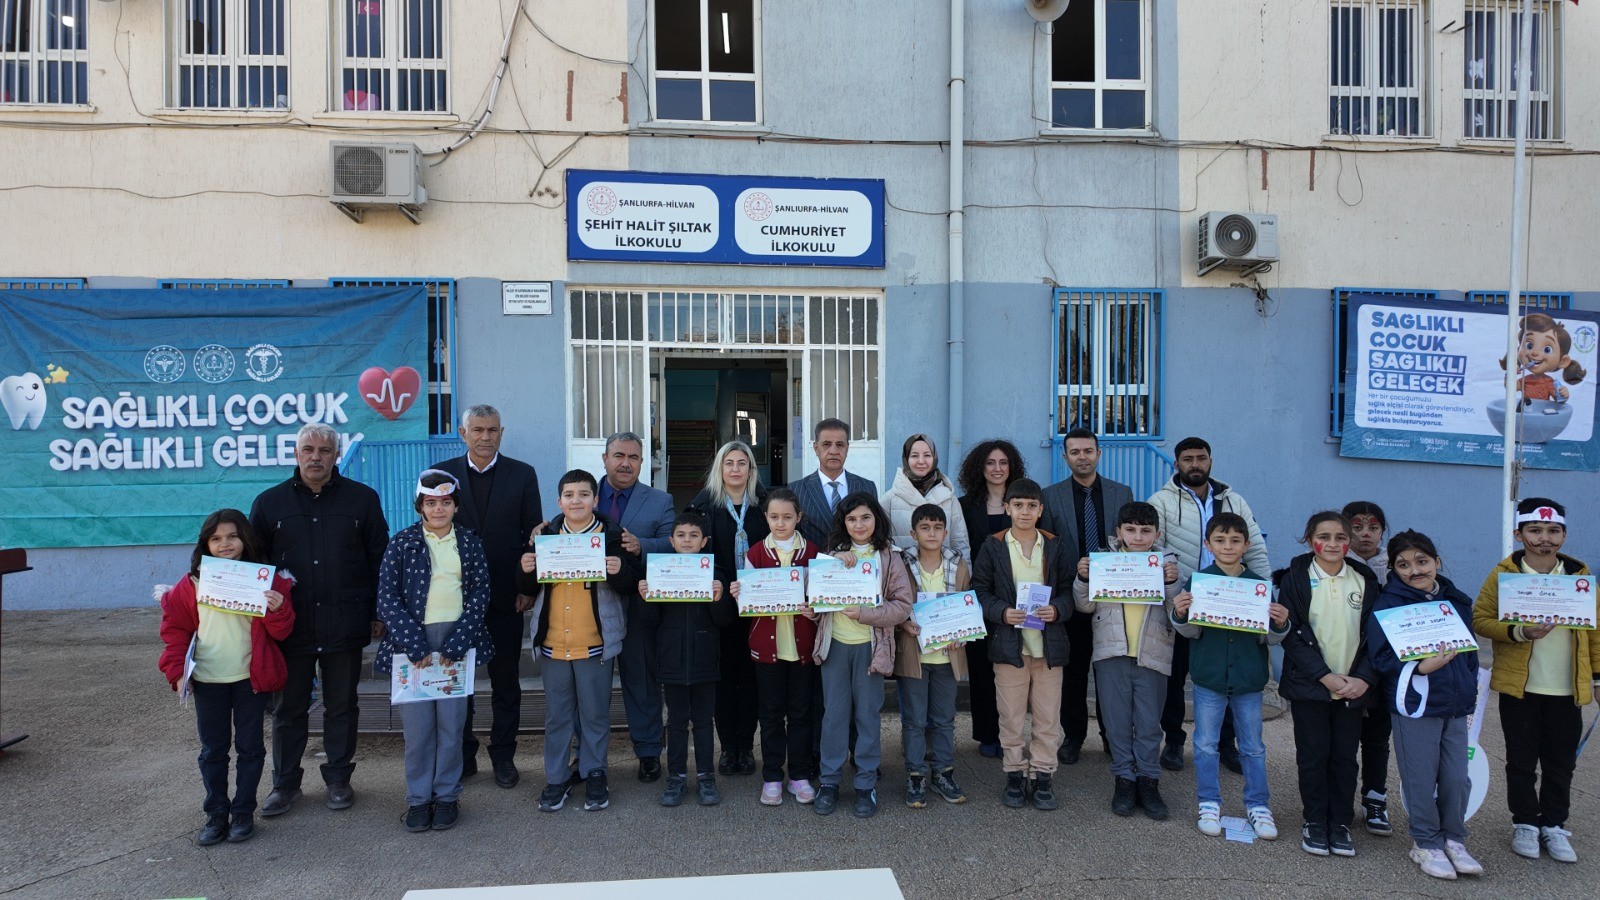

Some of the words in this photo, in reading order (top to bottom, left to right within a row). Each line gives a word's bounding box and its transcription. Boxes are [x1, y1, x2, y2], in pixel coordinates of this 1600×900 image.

[618, 198, 695, 210] ŞANLIURFA-HİLVAN
[774, 203, 849, 214] ŞANLIURFA-HİLVAN
[584, 217, 623, 232] ŞEHİT
[626, 218, 666, 232] HALİT
[668, 220, 712, 235] ŞILTAK
[760, 224, 847, 238] CUMHURİYET
[615, 236, 682, 249] İLKOKULU
[771, 239, 836, 254] İLKOKULU
[1370, 371, 1462, 394] GELECEK
[62, 391, 217, 430] SAĞLIKLI
[224, 391, 349, 431] ÇOCUK
[49, 432, 204, 471] SAĞLIKLI
[212, 432, 365, 468] GELEK
